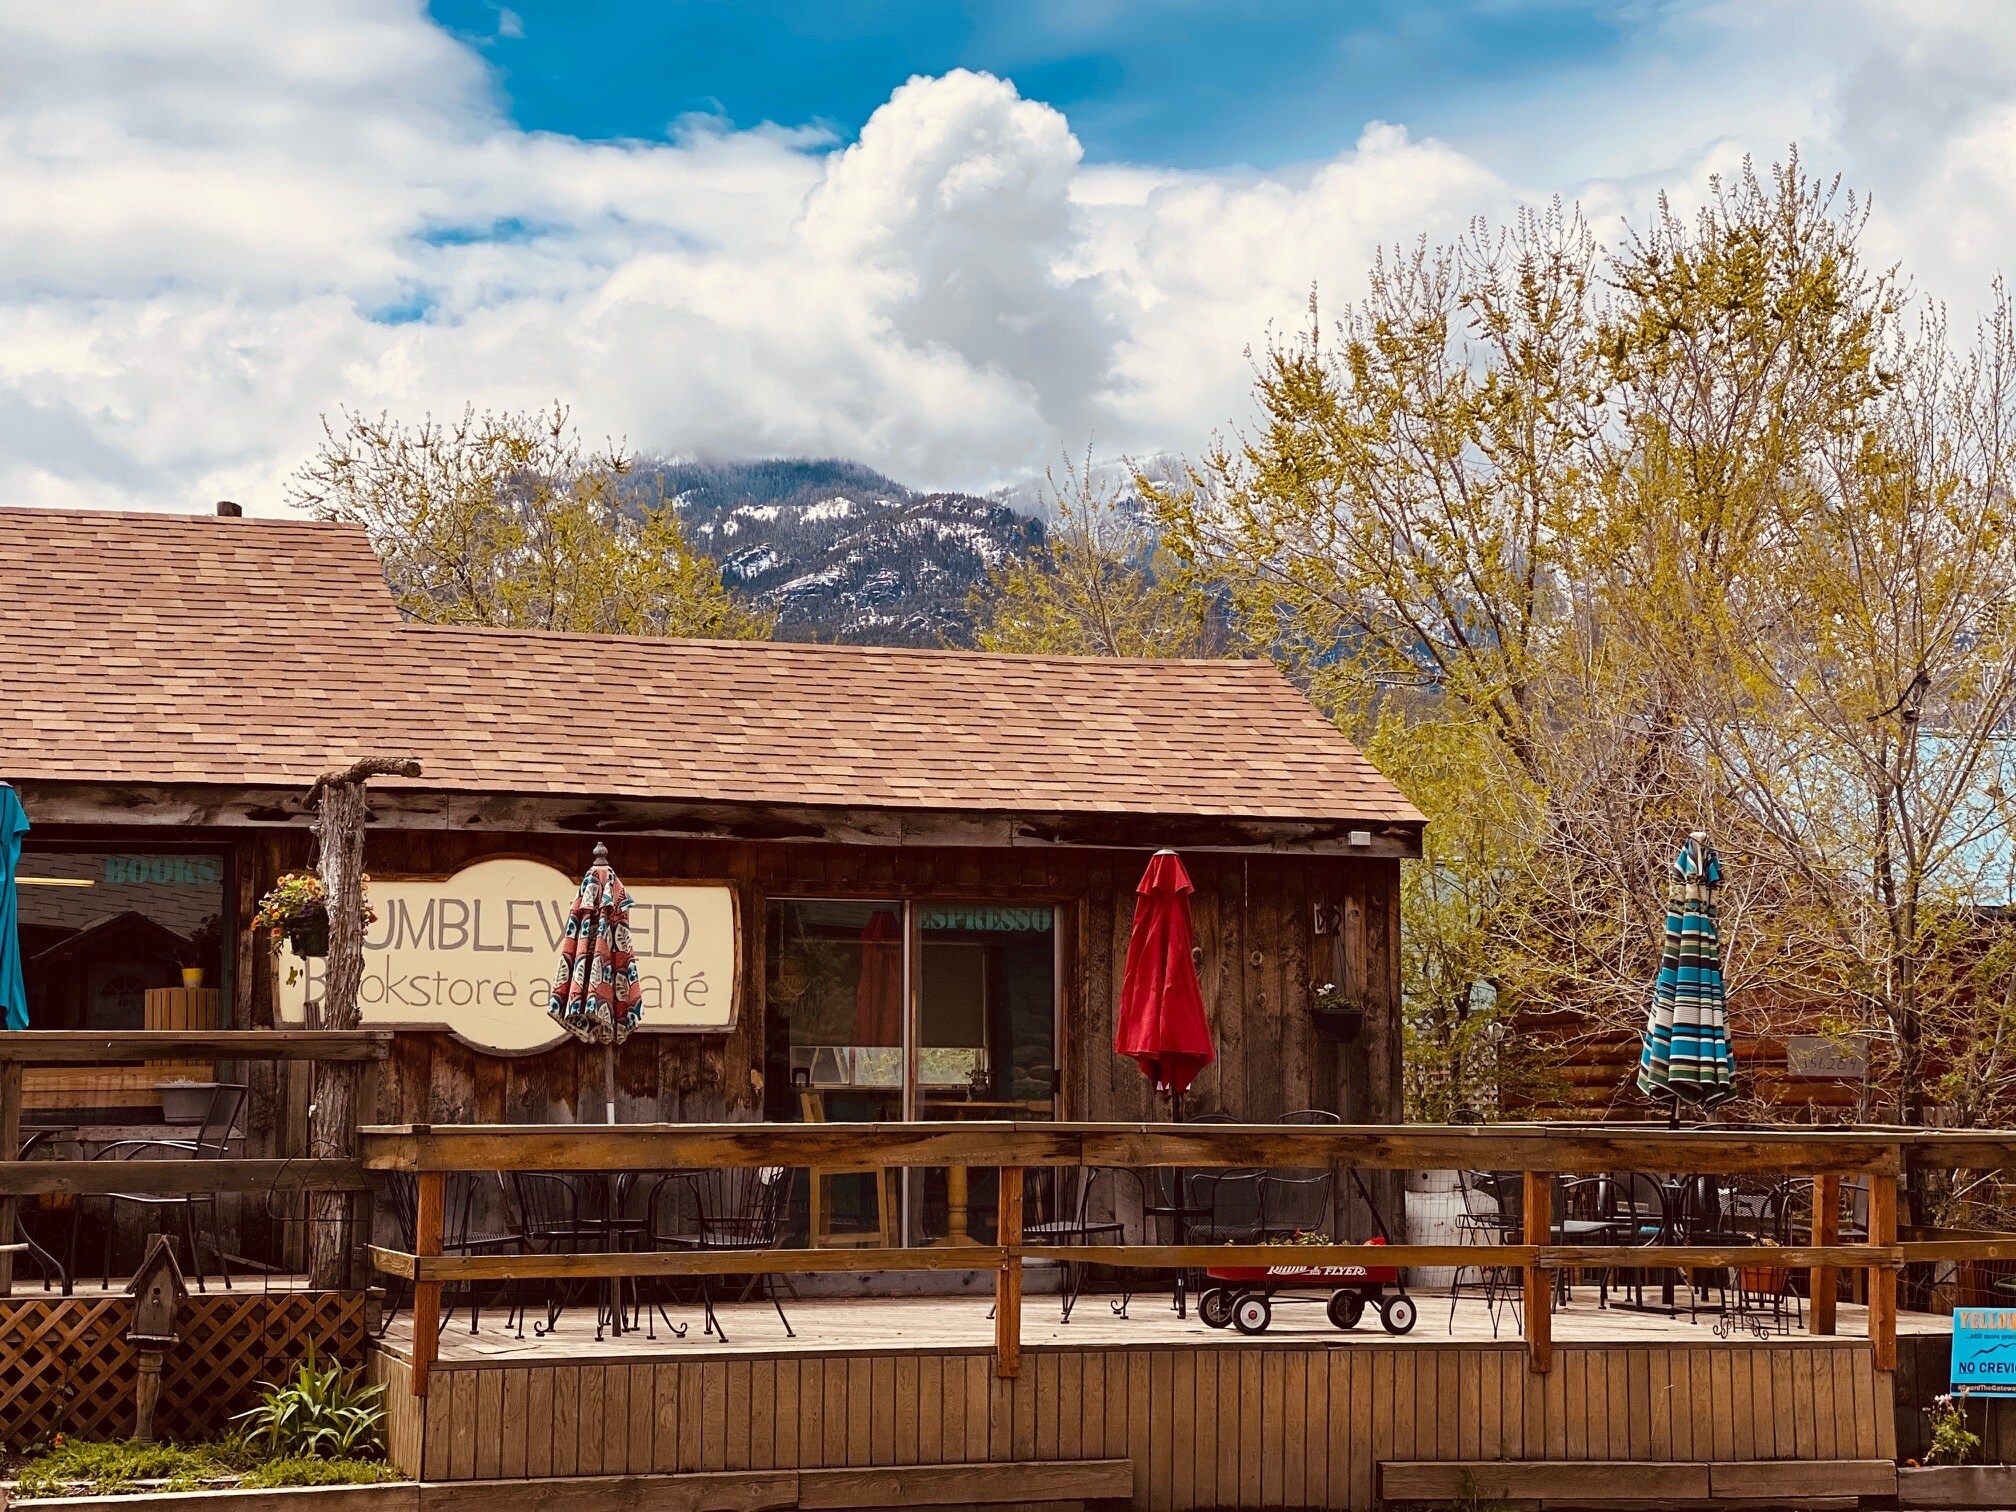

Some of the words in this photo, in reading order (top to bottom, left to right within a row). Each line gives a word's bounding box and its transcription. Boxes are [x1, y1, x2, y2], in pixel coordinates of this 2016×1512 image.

[104, 856, 218, 884] BOOKS
[363, 898, 690, 960] UMBLEWED
[304, 953, 518, 1008] Bokstore
[636, 958, 710, 1010] afé
[1322, 1265, 1367, 1276] FLYER
[1959, 1361, 1975, 1373] NO
[1979, 1361, 2016, 1373] CREVI
